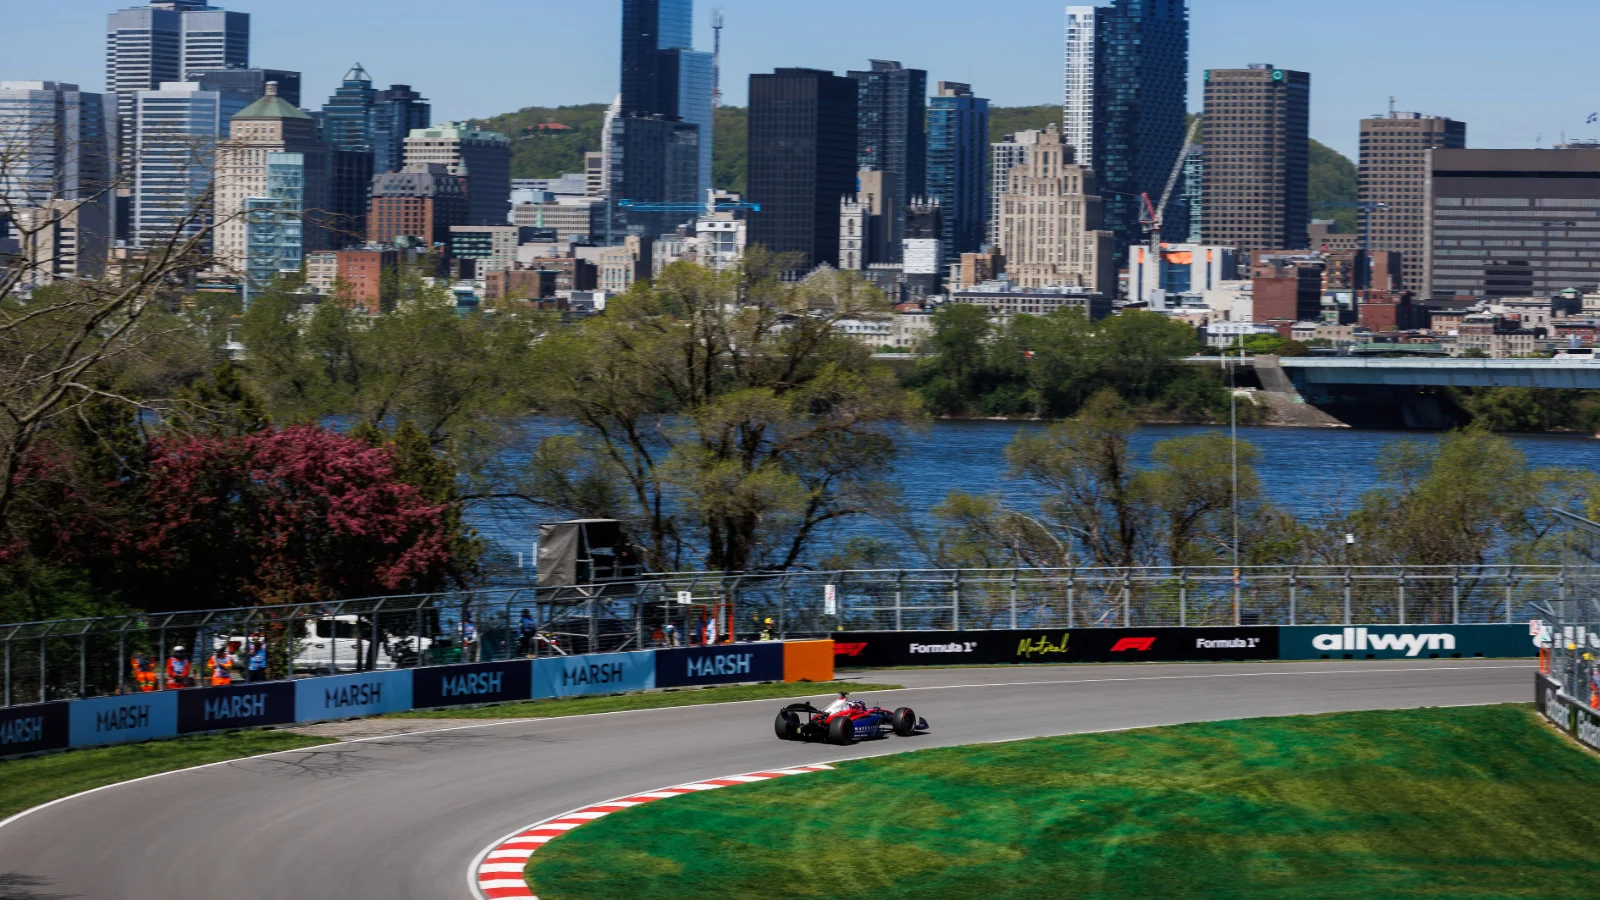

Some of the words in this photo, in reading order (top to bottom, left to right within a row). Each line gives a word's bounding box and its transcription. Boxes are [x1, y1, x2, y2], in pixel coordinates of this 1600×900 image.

[909, 643, 962, 653] Formula
[1196, 638, 1246, 648] Formula
[1312, 627, 1455, 656] allwyn
[563, 662, 623, 686] MARSH
[686, 653, 751, 676] MARSH
[324, 683, 381, 709] MARSH
[442, 672, 501, 697] MARSH
[96, 705, 149, 732] MARSH
[204, 695, 265, 721] MARSH
